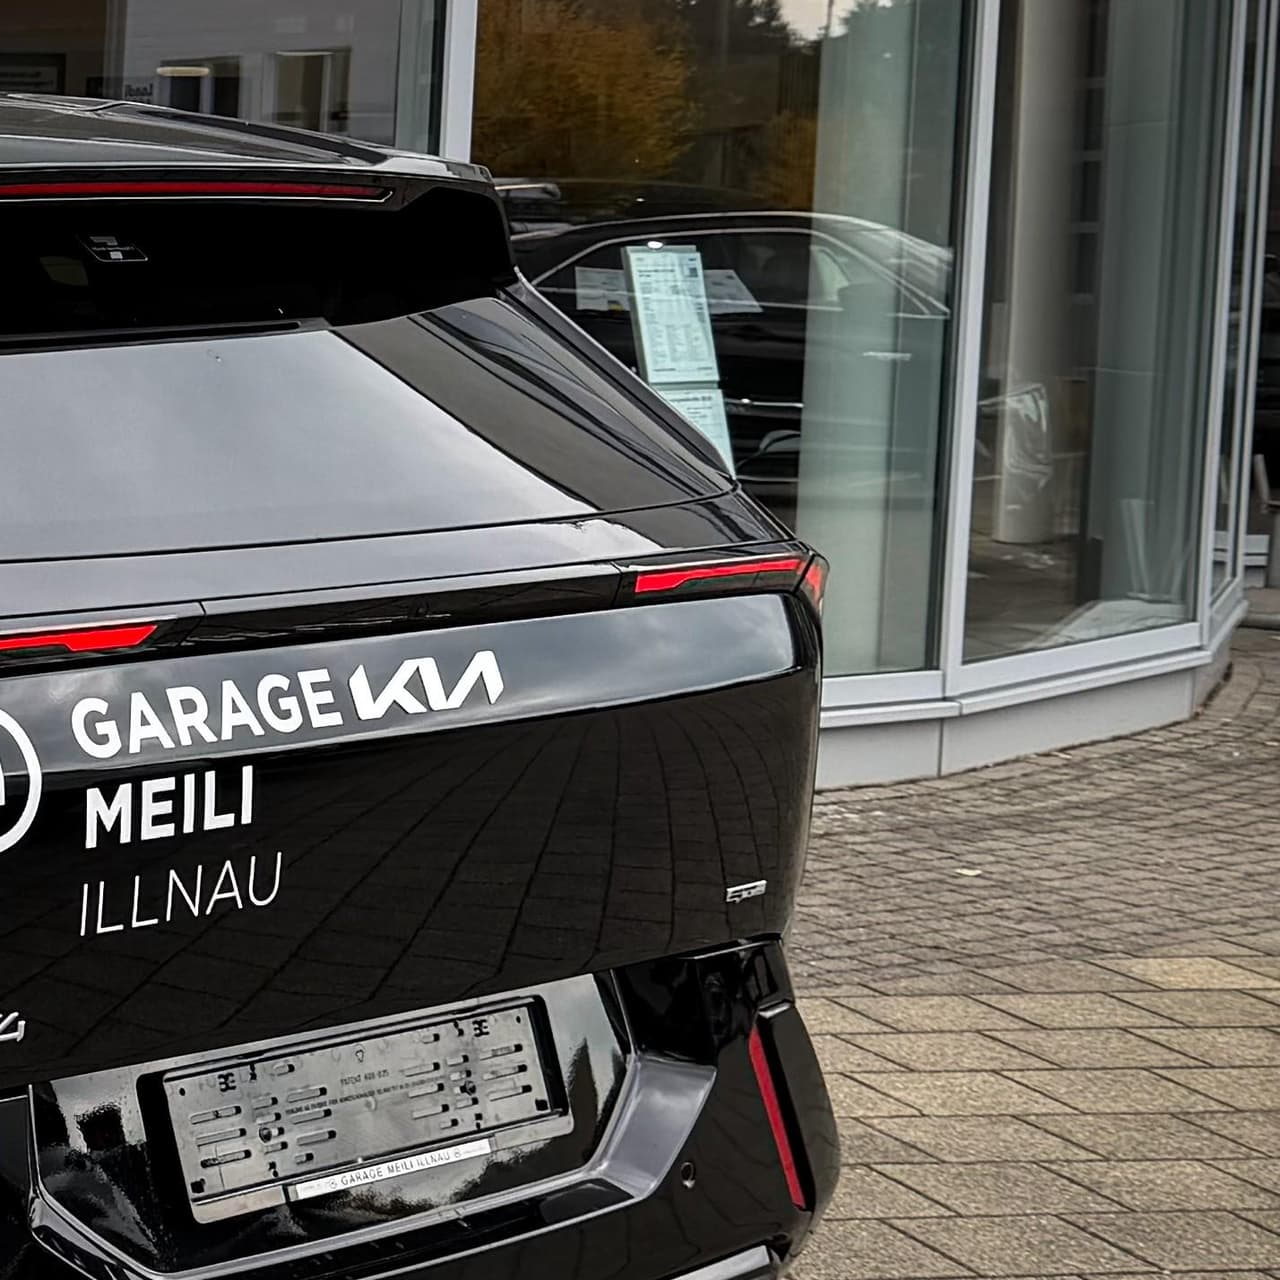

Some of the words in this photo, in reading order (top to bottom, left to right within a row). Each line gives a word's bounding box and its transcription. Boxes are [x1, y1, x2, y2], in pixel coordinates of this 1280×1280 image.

[70, 668, 344, 759] GARAGE
[346, 650, 504, 721] KIA
[84, 765, 255, 849] MEILI
[78, 850, 283, 937] ILLNAU
[340, 1166, 383, 1187] GARAGE
